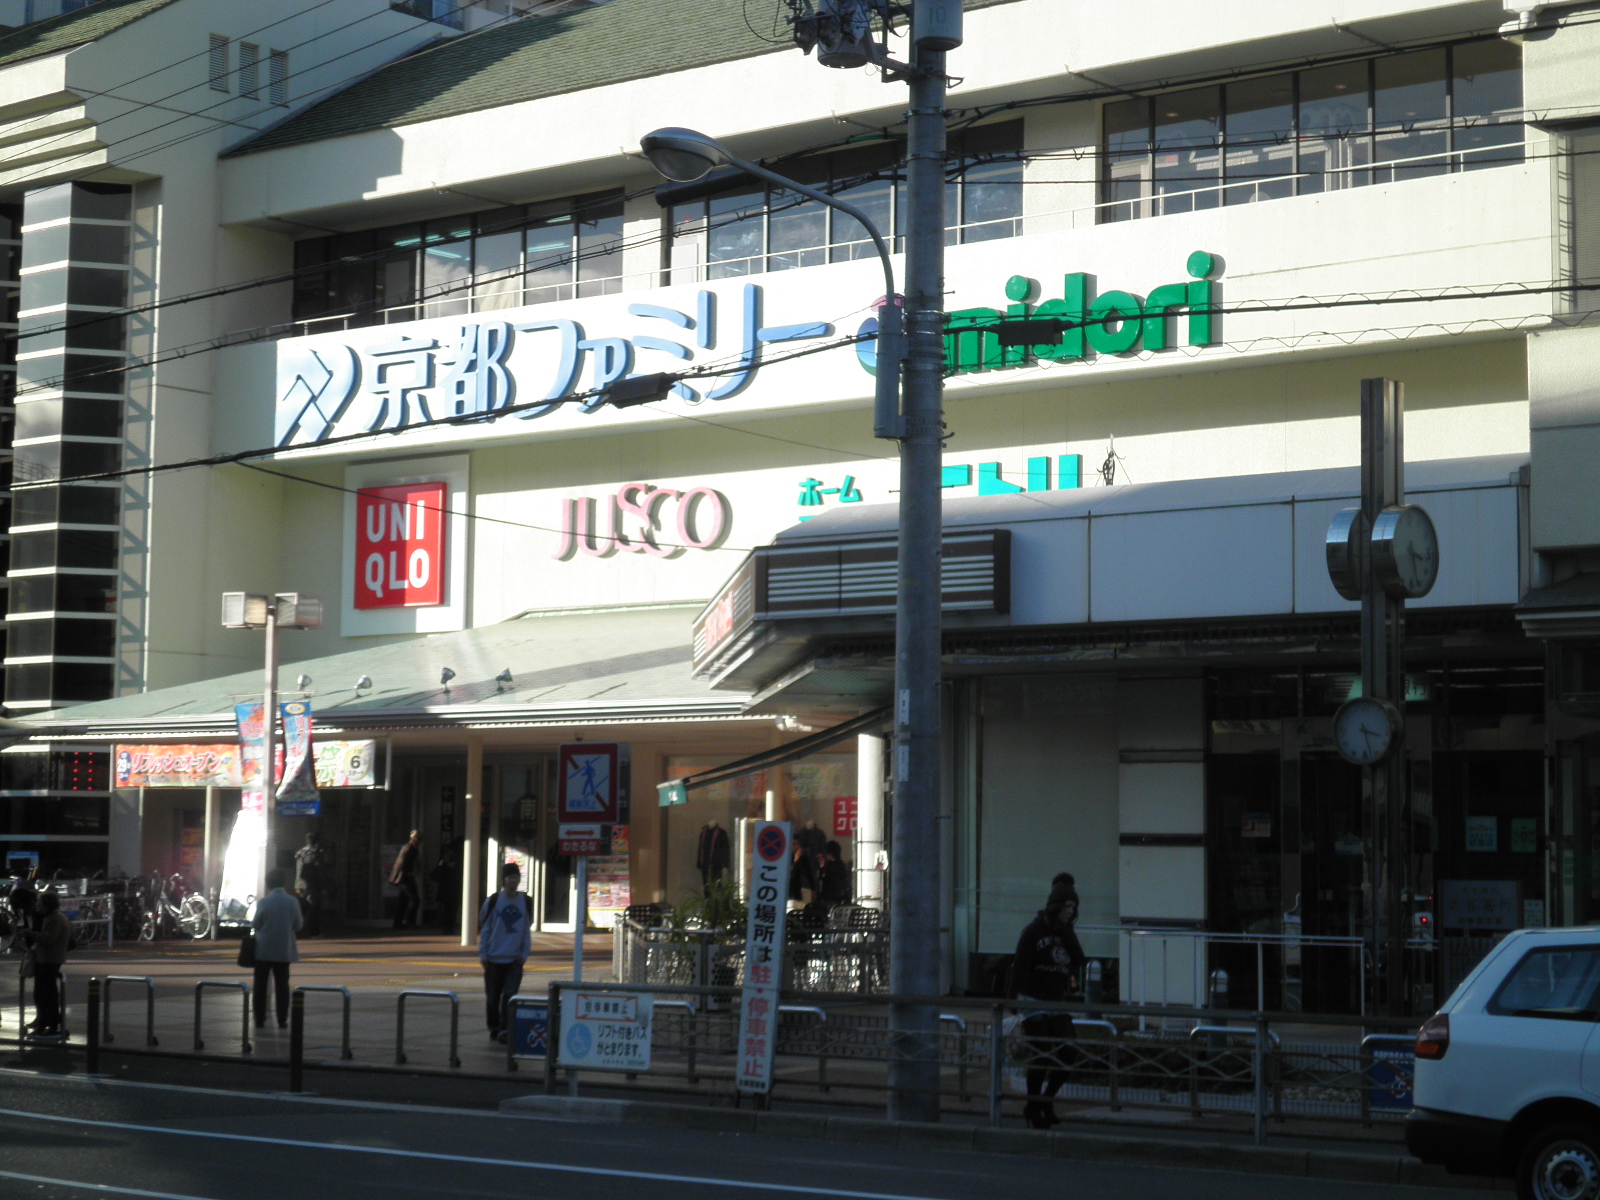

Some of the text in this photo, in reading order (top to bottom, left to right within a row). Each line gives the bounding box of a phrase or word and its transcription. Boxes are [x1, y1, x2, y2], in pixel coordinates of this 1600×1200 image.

[943, 250, 1214, 373] midori
[363, 283, 830, 432] 京都ファミリー
[798, 474, 862, 506] ホーム
[366, 499, 426, 544] UNI
[552, 482, 724, 560] JUSCO
[364, 548, 430, 599] QLO
[132, 751, 220, 774] リフレッシュオープン
[319, 746, 341, 781] 祭
[351, 755, 361, 769] 6
[562, 841, 597, 852] わたるな
[598, 1024, 647, 1041] リフト付きバス
[596, 1041, 642, 1058] がとまります。
